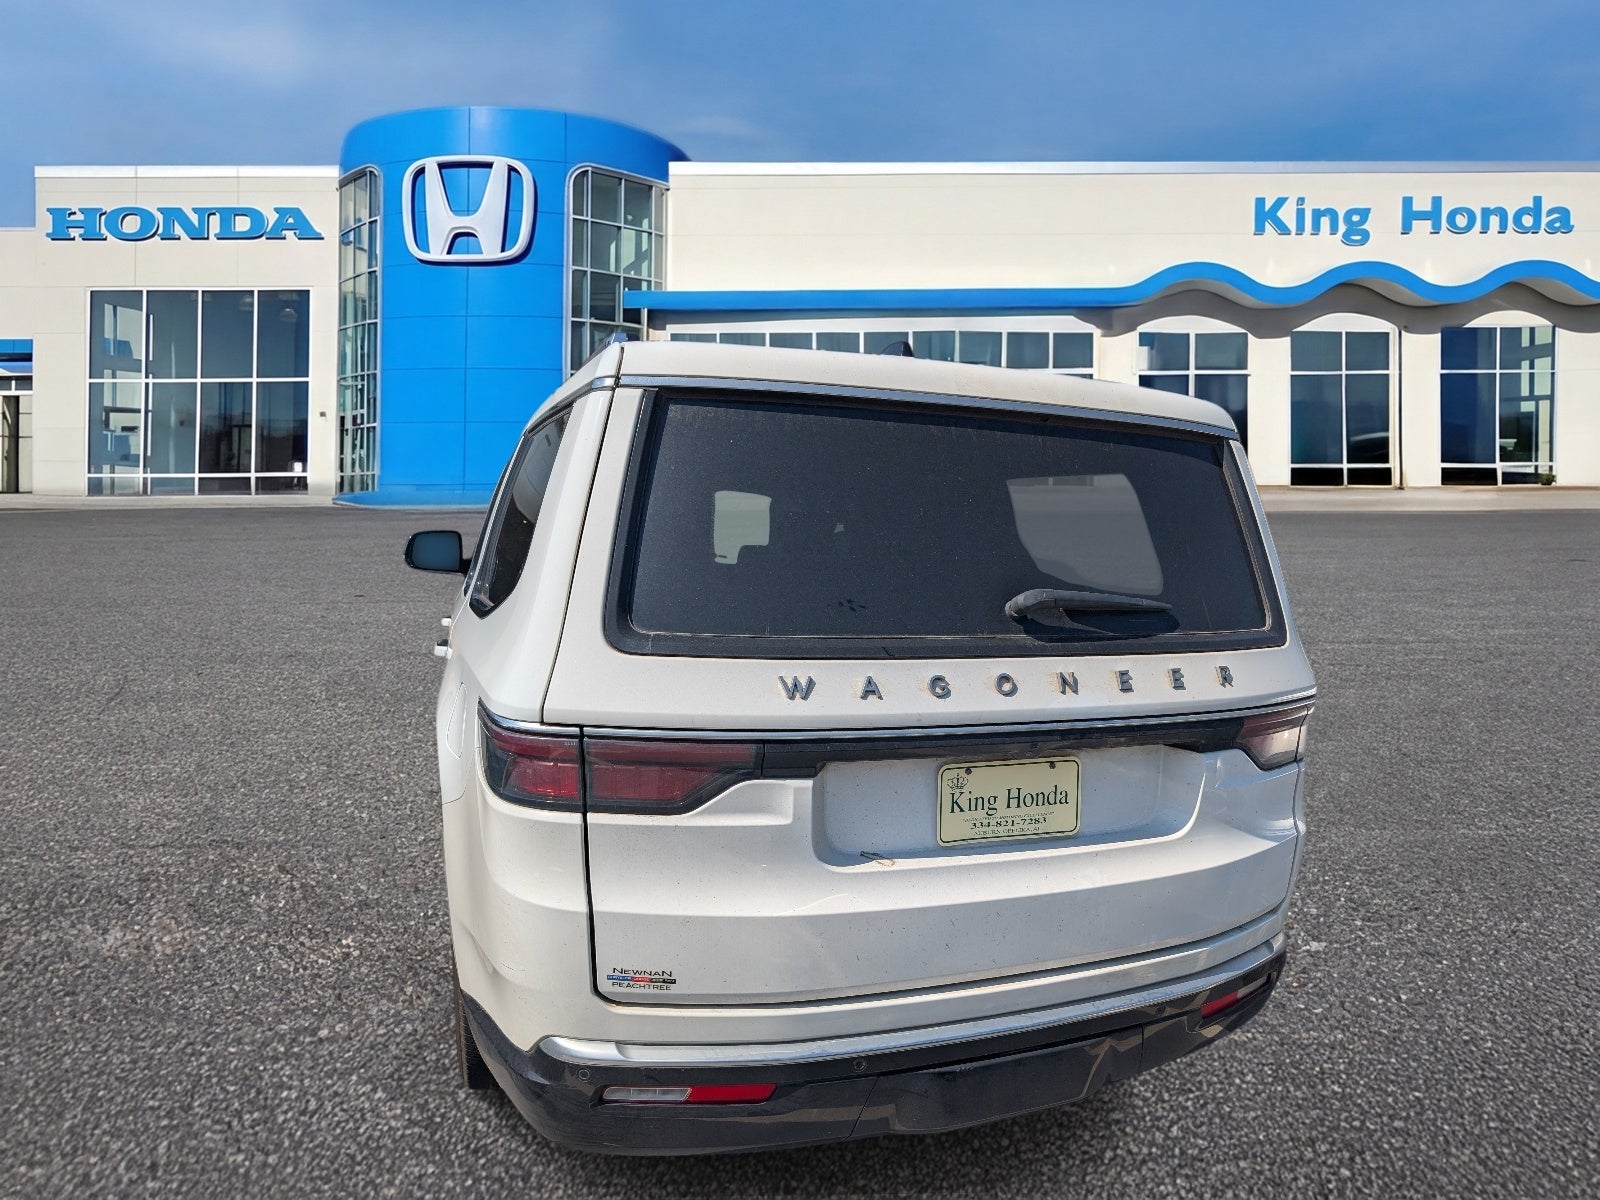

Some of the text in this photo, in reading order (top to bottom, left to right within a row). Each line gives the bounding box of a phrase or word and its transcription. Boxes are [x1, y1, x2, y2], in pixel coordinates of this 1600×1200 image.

[45, 206, 324, 242] HONDA
[1253, 195, 1575, 246] King Honda
[778, 664, 1234, 701] WAGONEER
[949, 784, 1069, 816] King Honda
[970, 816, 1047, 830] 334-821-7283
[612, 981, 672, 991] PEACHTREE
